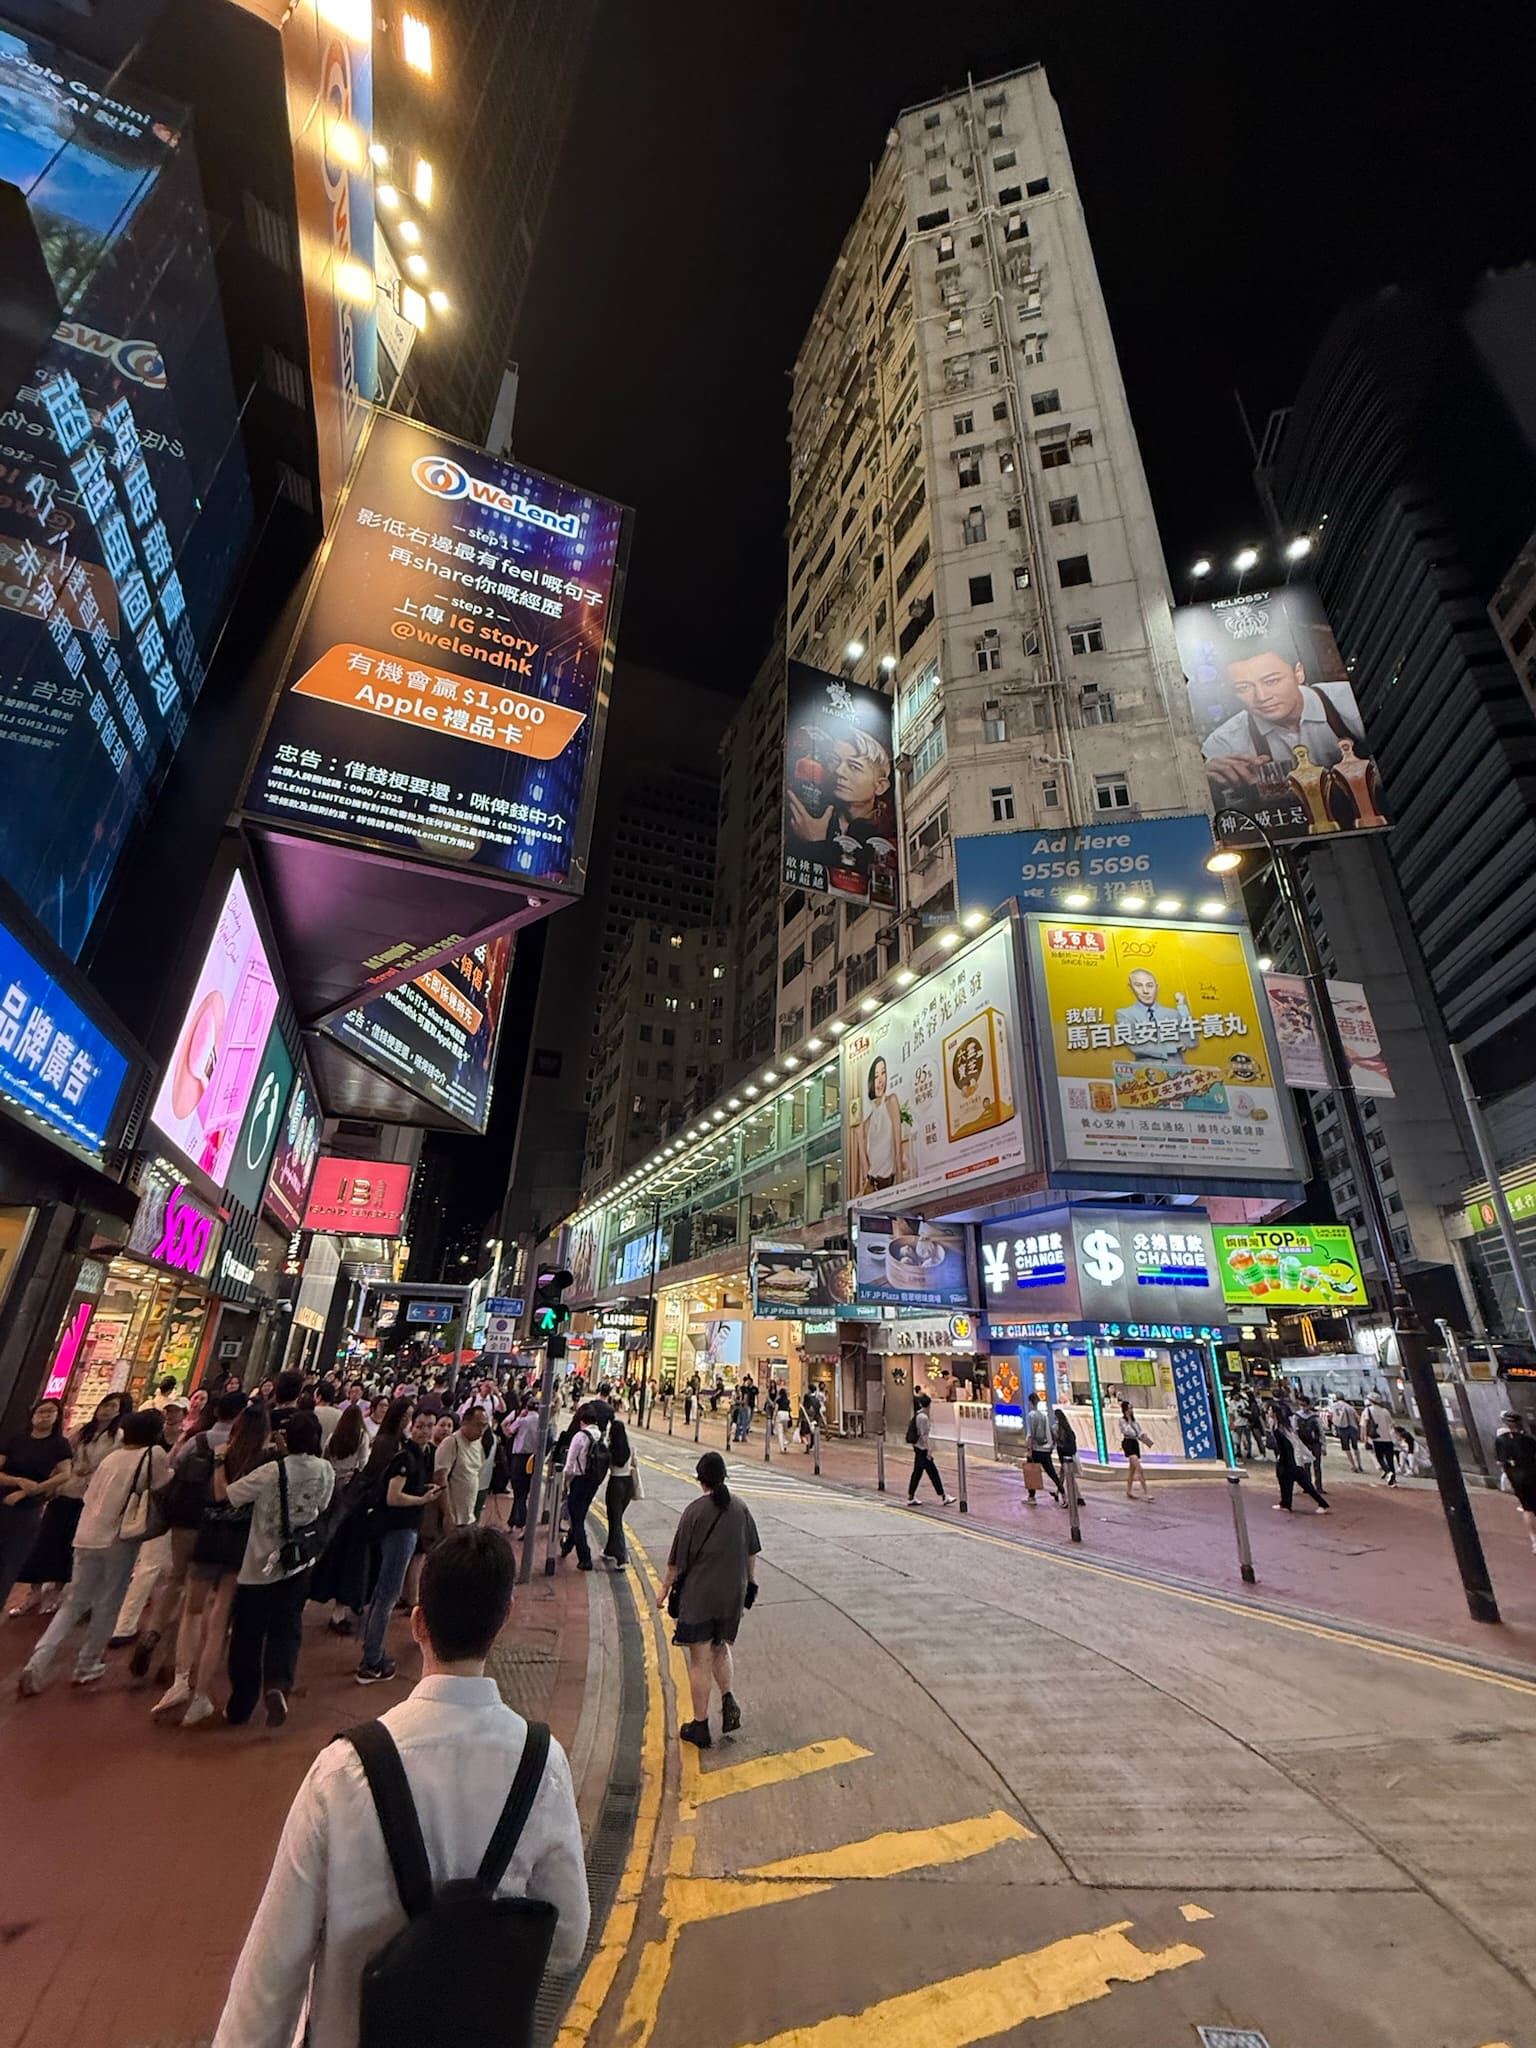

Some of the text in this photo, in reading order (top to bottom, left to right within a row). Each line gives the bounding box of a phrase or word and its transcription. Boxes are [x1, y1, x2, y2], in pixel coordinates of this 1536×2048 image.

[69, 81, 151, 124] Gemini
[471, 481, 575, 535] WeLend
[468, 528, 498, 548] step
[501, 559, 539, 586] feel
[450, 598, 495, 619] step 2
[1211, 591, 1270, 610] HELIOSSY
[394, 598, 539, 656] 上傳 IG story
[390, 620, 533, 677] @welendhk
[346, 652, 546, 725] 有機會贏 $1,000
[354, 685, 438, 721] Apple
[267, 779, 311, 796] WELEND
[1220, 806, 1308, 834] 神之威士忌
[1032, 834, 1132, 855] Ad Here
[1021, 854, 1151, 881] 9556 5696
[1066, 1013, 1248, 1051] 馬百良安宮牛黃丸
[1015, 1250, 1065, 1269] CHANGE
[1135, 1250, 1208, 1267] CHANGE
[880, 1291, 900, 1302] Plaza
[602, 1313, 634, 1326] LUSH
[1007, 1323, 1051, 1337] CHANGE
[1127, 1323, 1195, 1339] CHANGE
